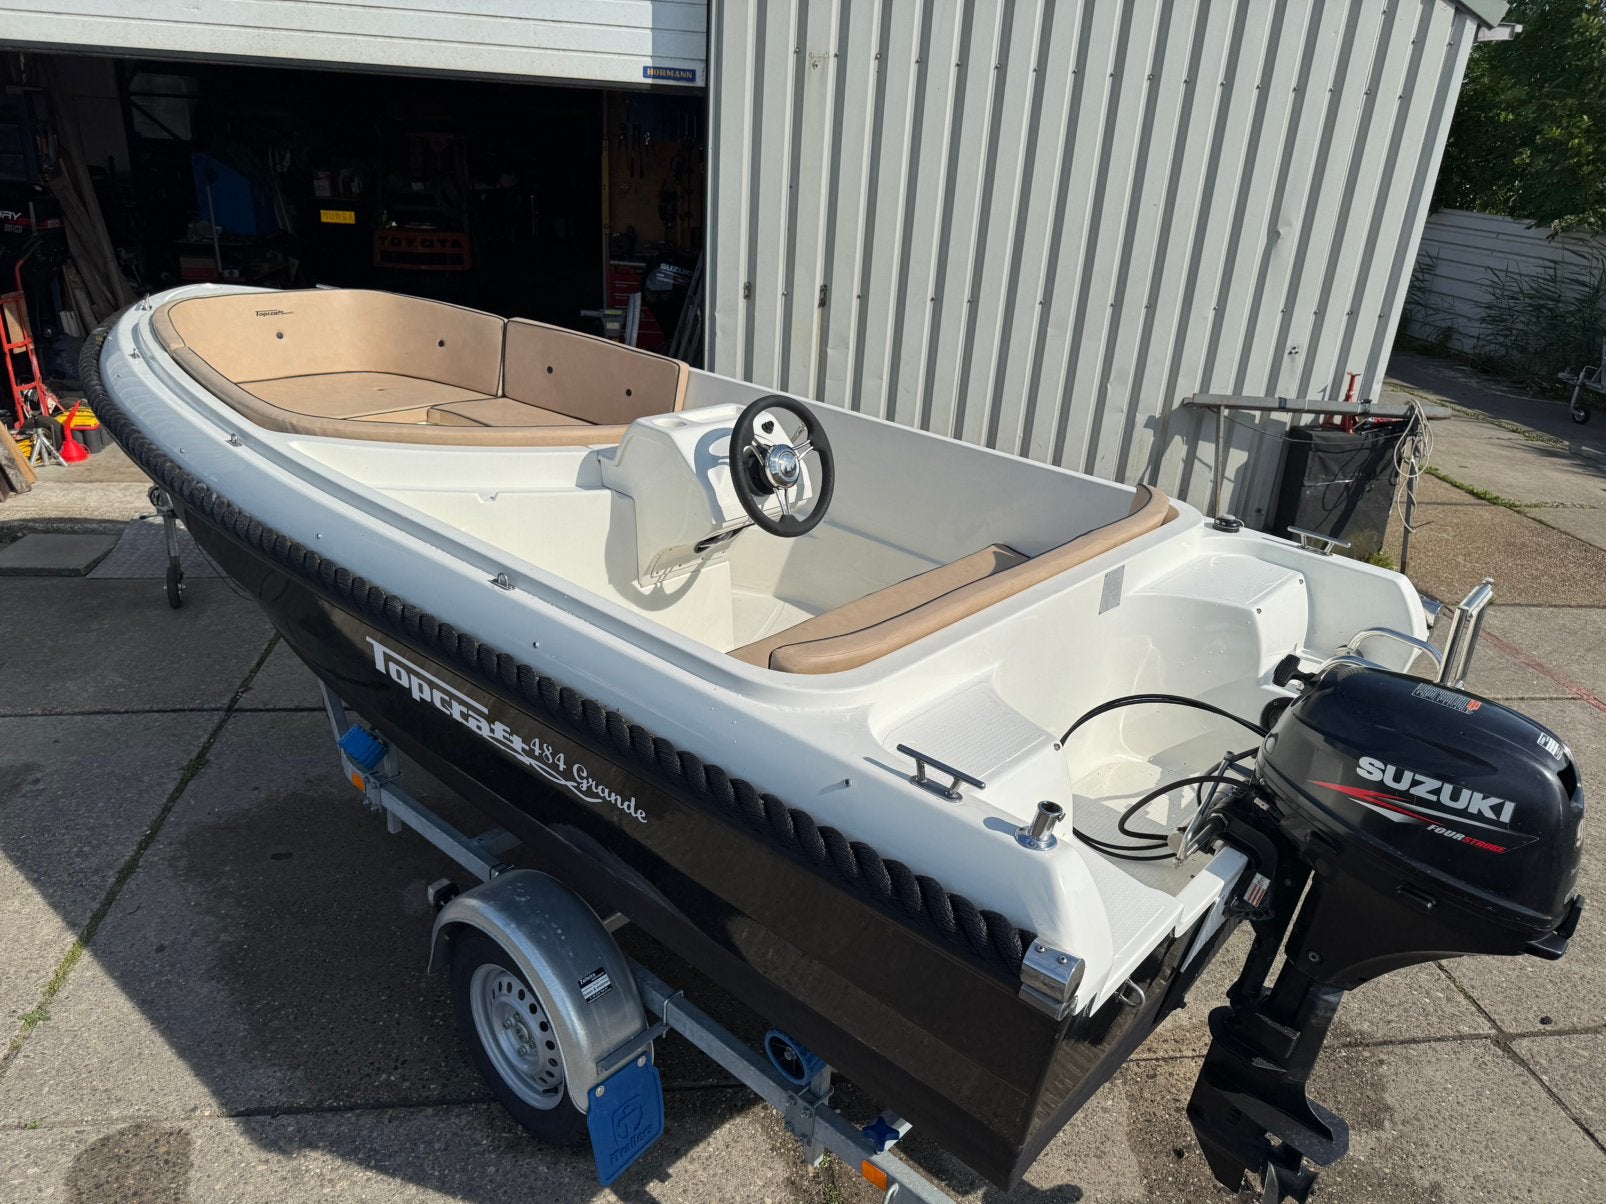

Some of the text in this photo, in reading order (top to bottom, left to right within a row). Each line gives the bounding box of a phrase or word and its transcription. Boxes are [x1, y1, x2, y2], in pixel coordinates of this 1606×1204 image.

[378, 236, 463, 248] TOYOTA
[255, 309, 290, 317] Topcraft
[366, 636, 531, 760] Topcraft
[530, 738, 648, 823] 484 Grande
[1356, 756, 1516, 824] SUZUKI
